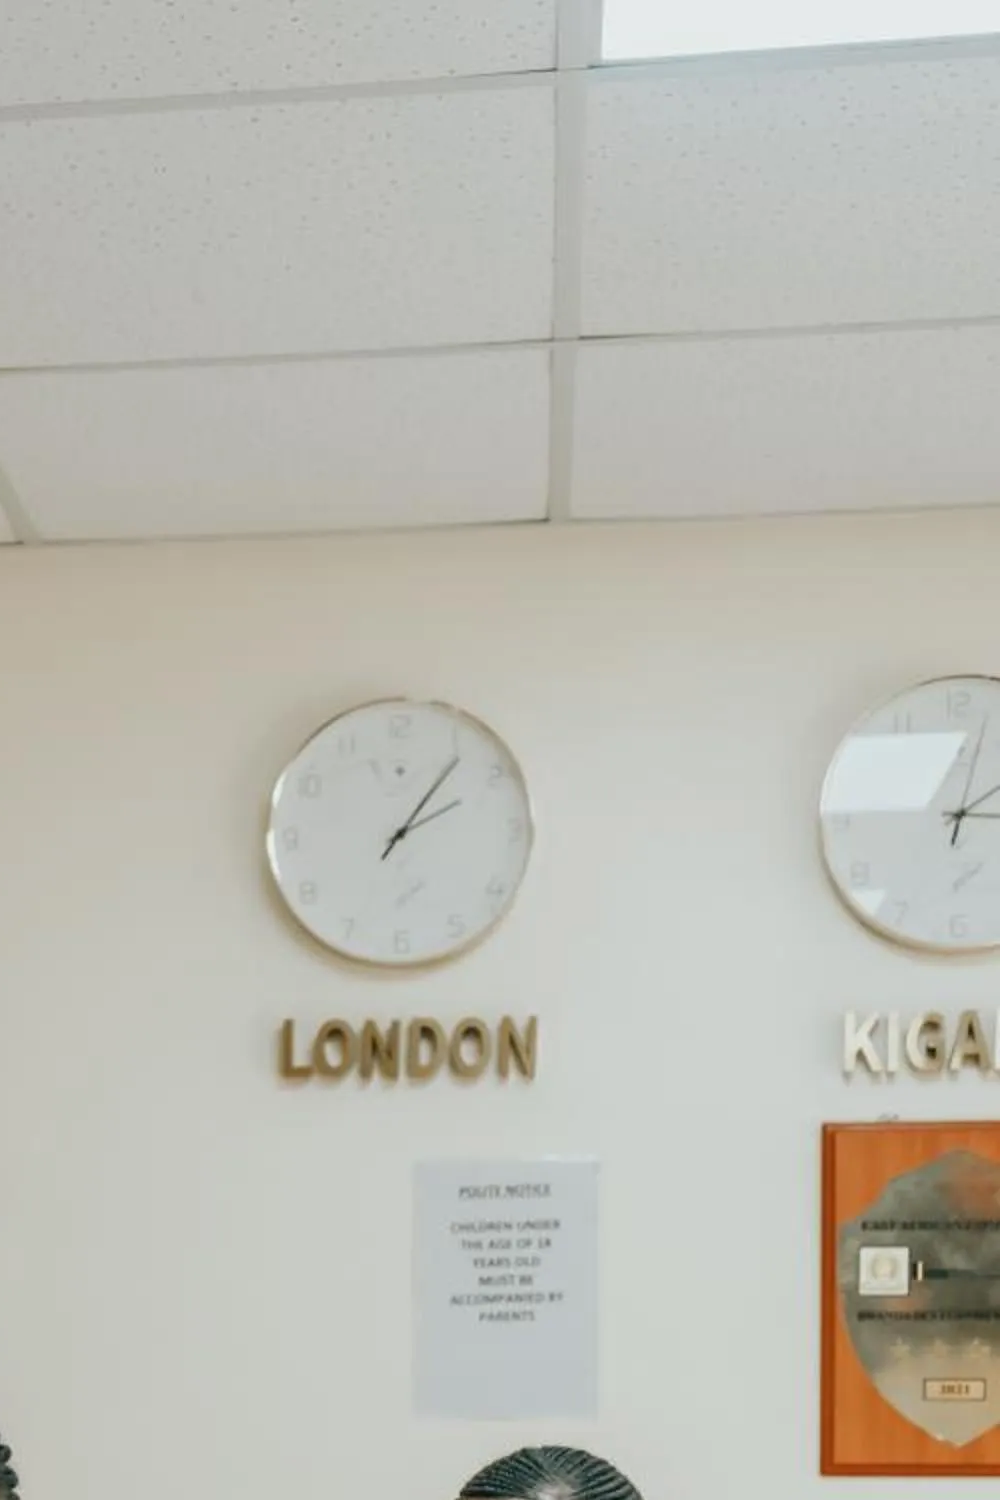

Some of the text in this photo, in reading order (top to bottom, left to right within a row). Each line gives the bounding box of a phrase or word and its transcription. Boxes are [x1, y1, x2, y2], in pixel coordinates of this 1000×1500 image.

[946, 688, 971, 719] 12
[388, 714, 412, 739] 12
[843, 1009, 1000, 1073] KIGA
[277, 1015, 538, 1083] LONDON
[450, 1219, 561, 1233] CHILDREN UNDER
[461, 1239, 483, 1251] THE
[488, 1238, 512, 1250] AGE
[516, 1238, 533, 1249] OF
[473, 1256, 541, 1269] YEARS OLD
[478, 1274, 534, 1286] MUST BE
[450, 1291, 564, 1306] ACCOMPANIED BY
[478, 1311, 536, 1322] PARENTS
